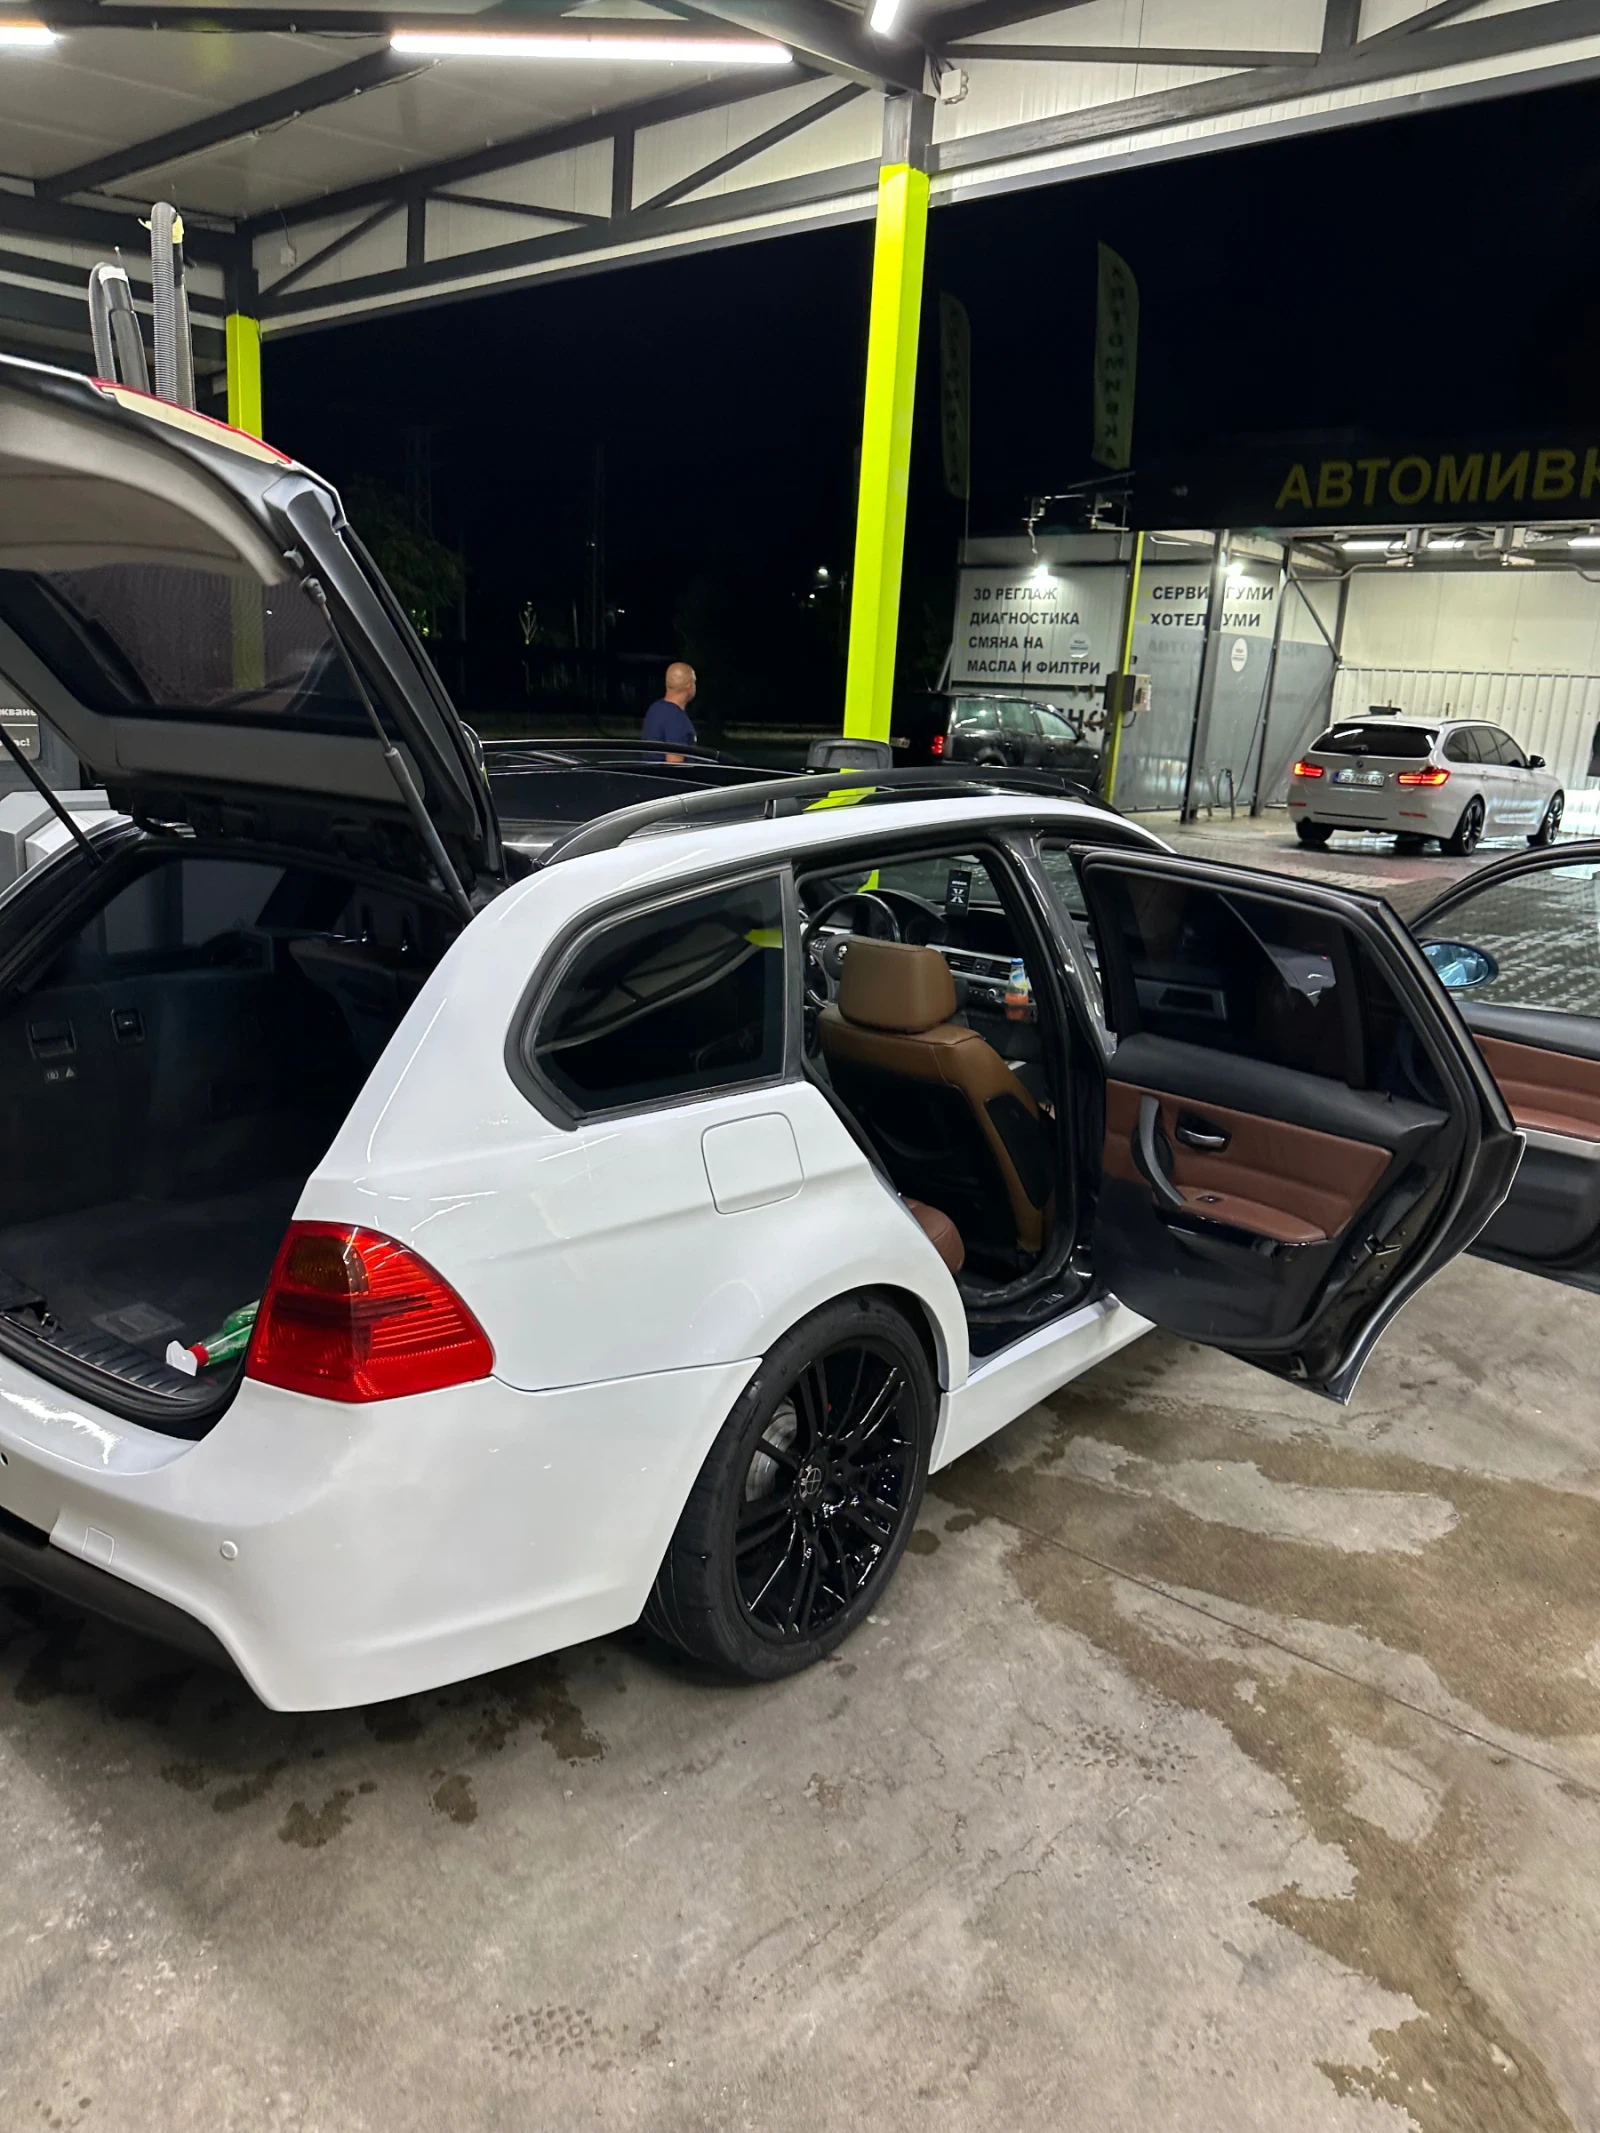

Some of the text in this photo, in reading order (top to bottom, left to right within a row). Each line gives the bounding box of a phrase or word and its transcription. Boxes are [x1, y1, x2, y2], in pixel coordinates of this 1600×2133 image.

[973, 588, 1058, 601] 3D РЕГЛАЖ
[1152, 586, 1274, 601] СЕРВИ ГУМИ
[969, 612, 1080, 627] ДИАГНОСТИКА
[1222, 614, 1260, 627] УМИ
[968, 636, 1044, 649] СМЯНА НА
[967, 660, 1100, 674] МАСЛА И ФИЛТРИ
